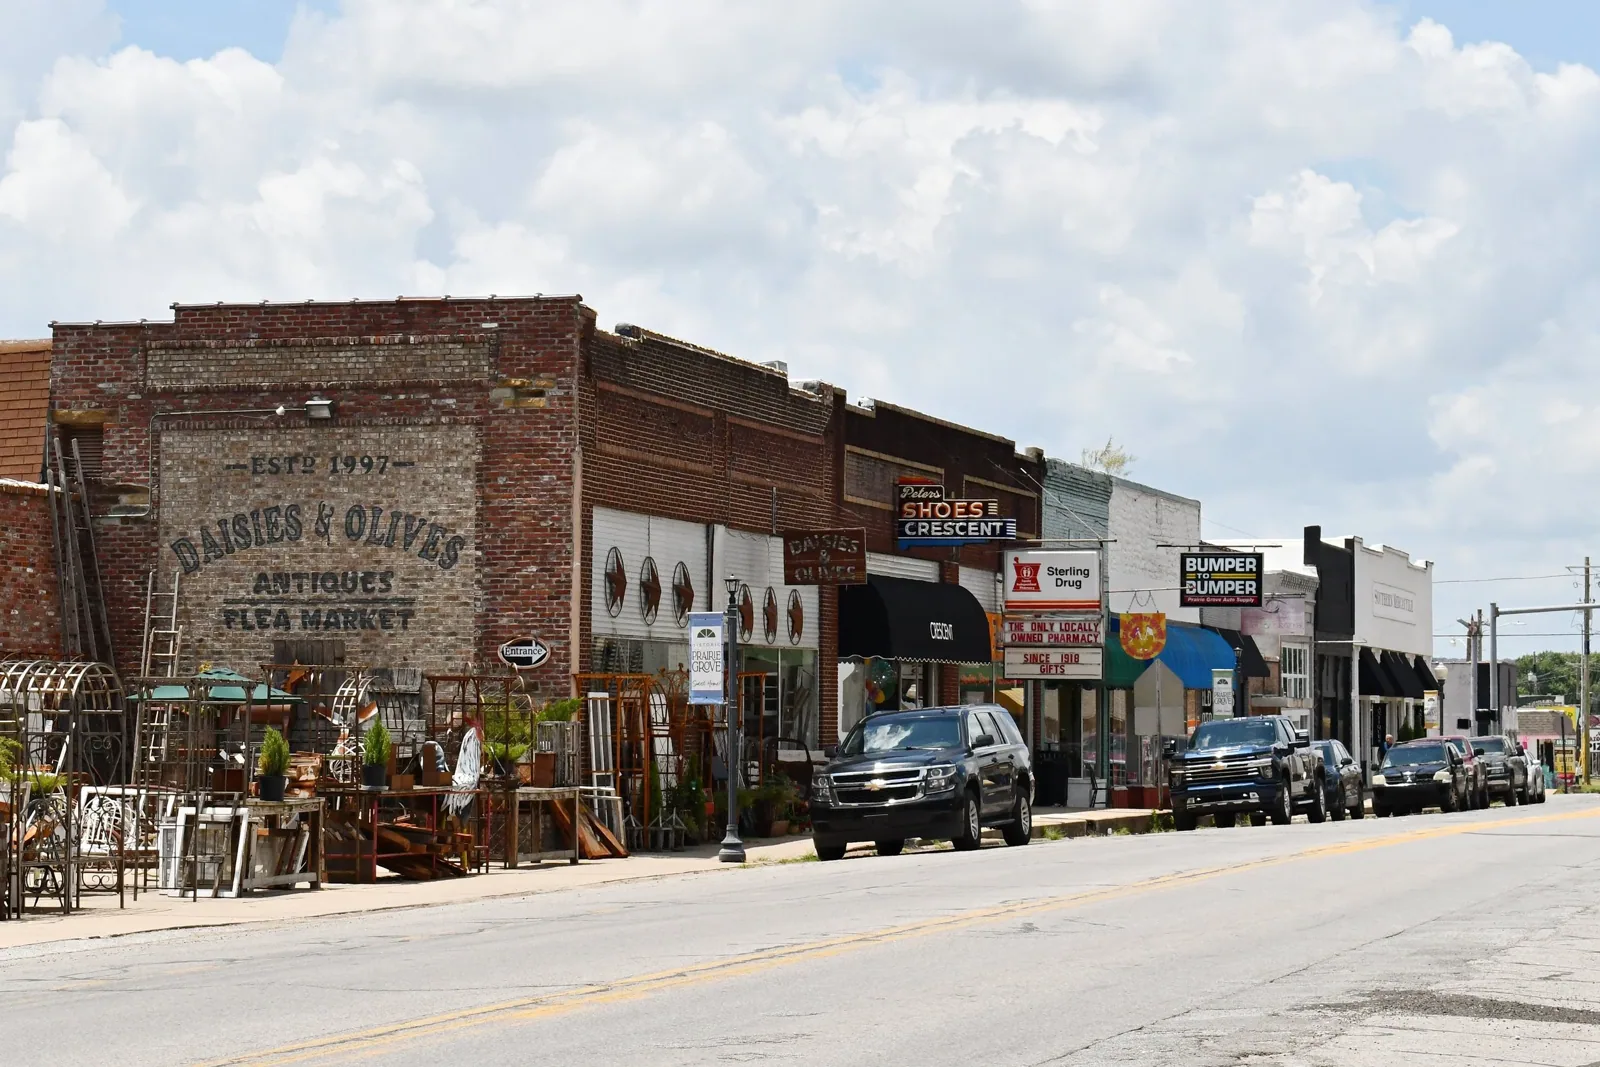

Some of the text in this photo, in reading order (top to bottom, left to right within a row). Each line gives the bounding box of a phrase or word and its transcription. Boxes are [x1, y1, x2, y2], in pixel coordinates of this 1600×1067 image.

[330, 455, 389, 475] 1997
[900, 486, 942, 498] Peters
[903, 502, 984, 518] SHOES
[904, 521, 1004, 536] CRESCENT
[170, 500, 466, 575] DAISIES & OLIVES
[788, 534, 860, 556] DAISIES
[1185, 557, 1257, 572] BUMPER
[794, 566, 857, 581] OLIVES
[1046, 566, 1090, 579] Sterling
[253, 571, 395, 594] ANTIQUES
[1055, 577, 1082, 590] Drug
[1185, 580, 1257, 595] BUMPER
[223, 608, 416, 631] FLEA MARKET
[1008, 622, 1100, 632] THE ONLY LOCALLY
[930, 622, 954, 640] CRESCENT
[1011, 633, 1100, 643] OWNED PHARMACY
[505, 647, 543, 656] Entrance
[692, 650, 721, 661] PRAIRIE
[1023, 654, 1080, 663] SINCE 1918
[692, 660, 721, 673] GROVE
[1040, 664, 1066, 674] GIFTS
